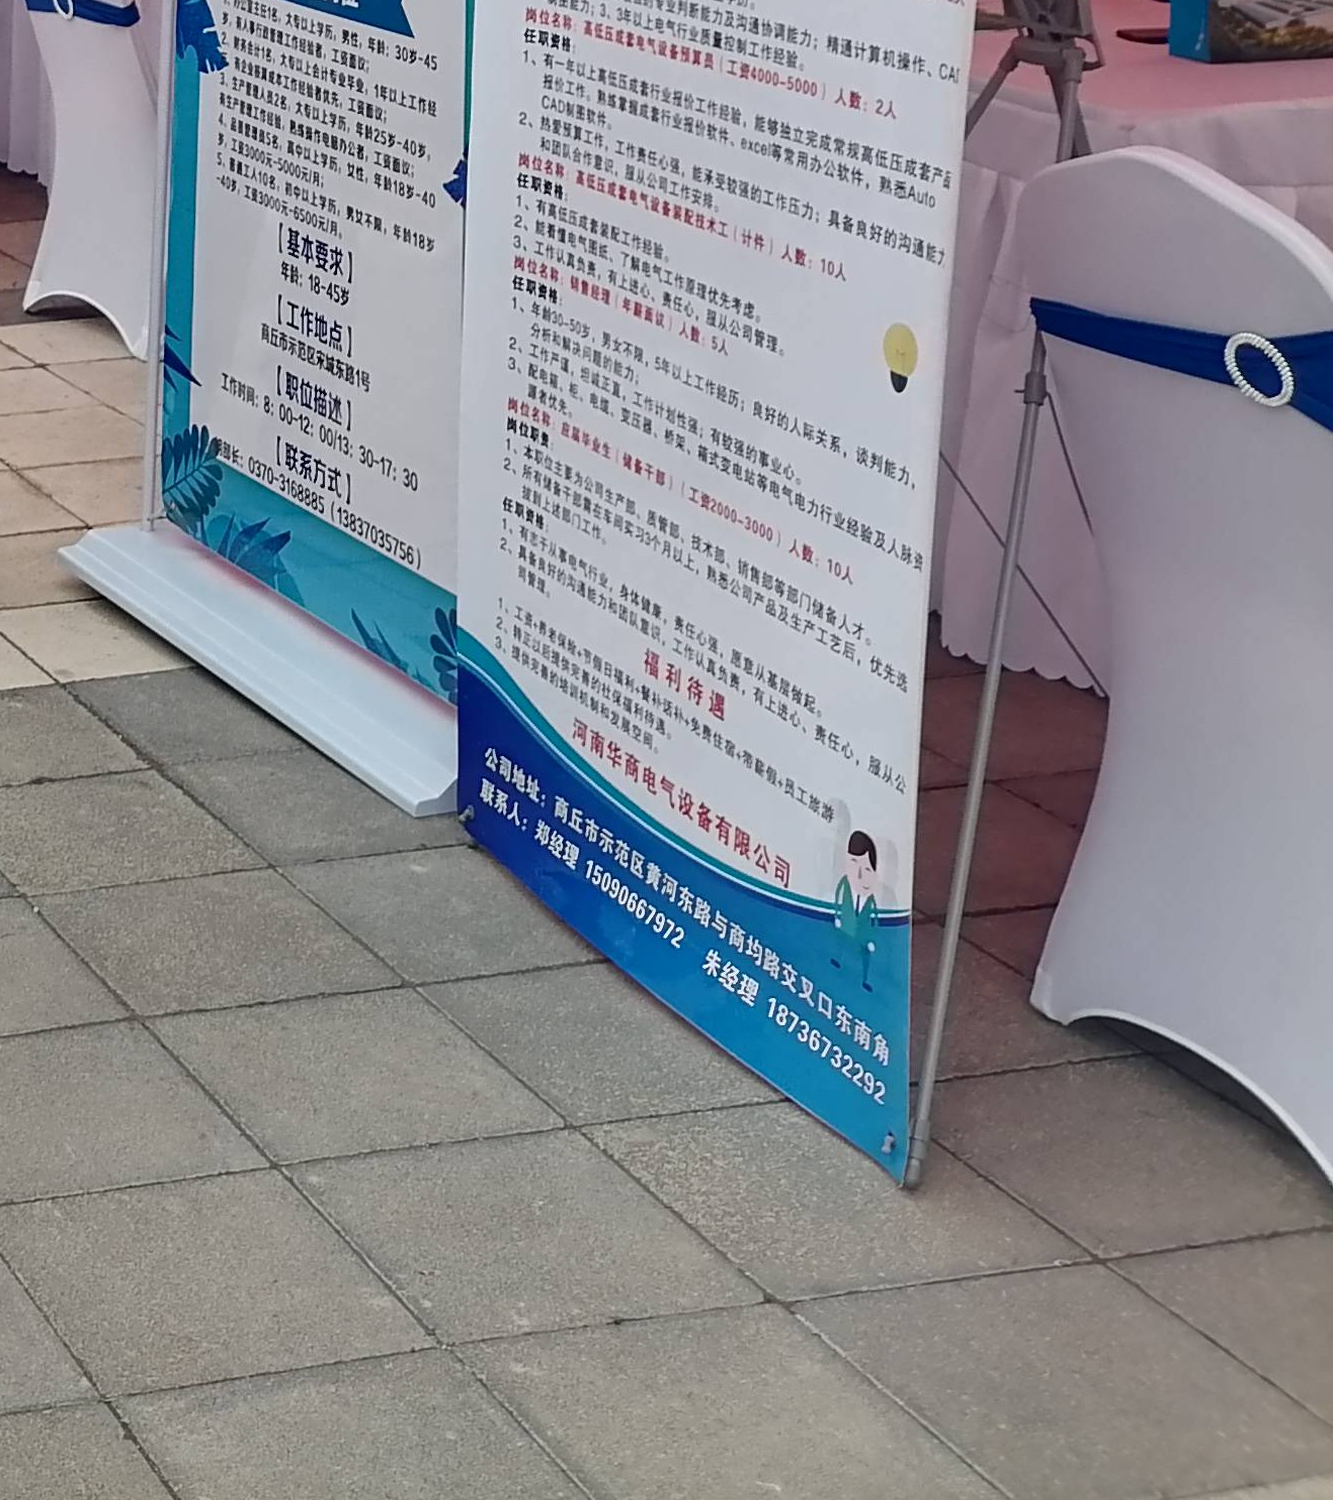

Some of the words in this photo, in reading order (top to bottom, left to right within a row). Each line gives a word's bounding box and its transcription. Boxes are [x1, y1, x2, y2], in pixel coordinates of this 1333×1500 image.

[643, 646, 726, 722] 福利待遇
[571, 714, 792, 891] 河南华商电气设备有限公司
[584, 855, 685, 954] 15090667972
[702, 944, 760, 1012] 朱经理
[766, 992, 887, 1107] 18736732292
